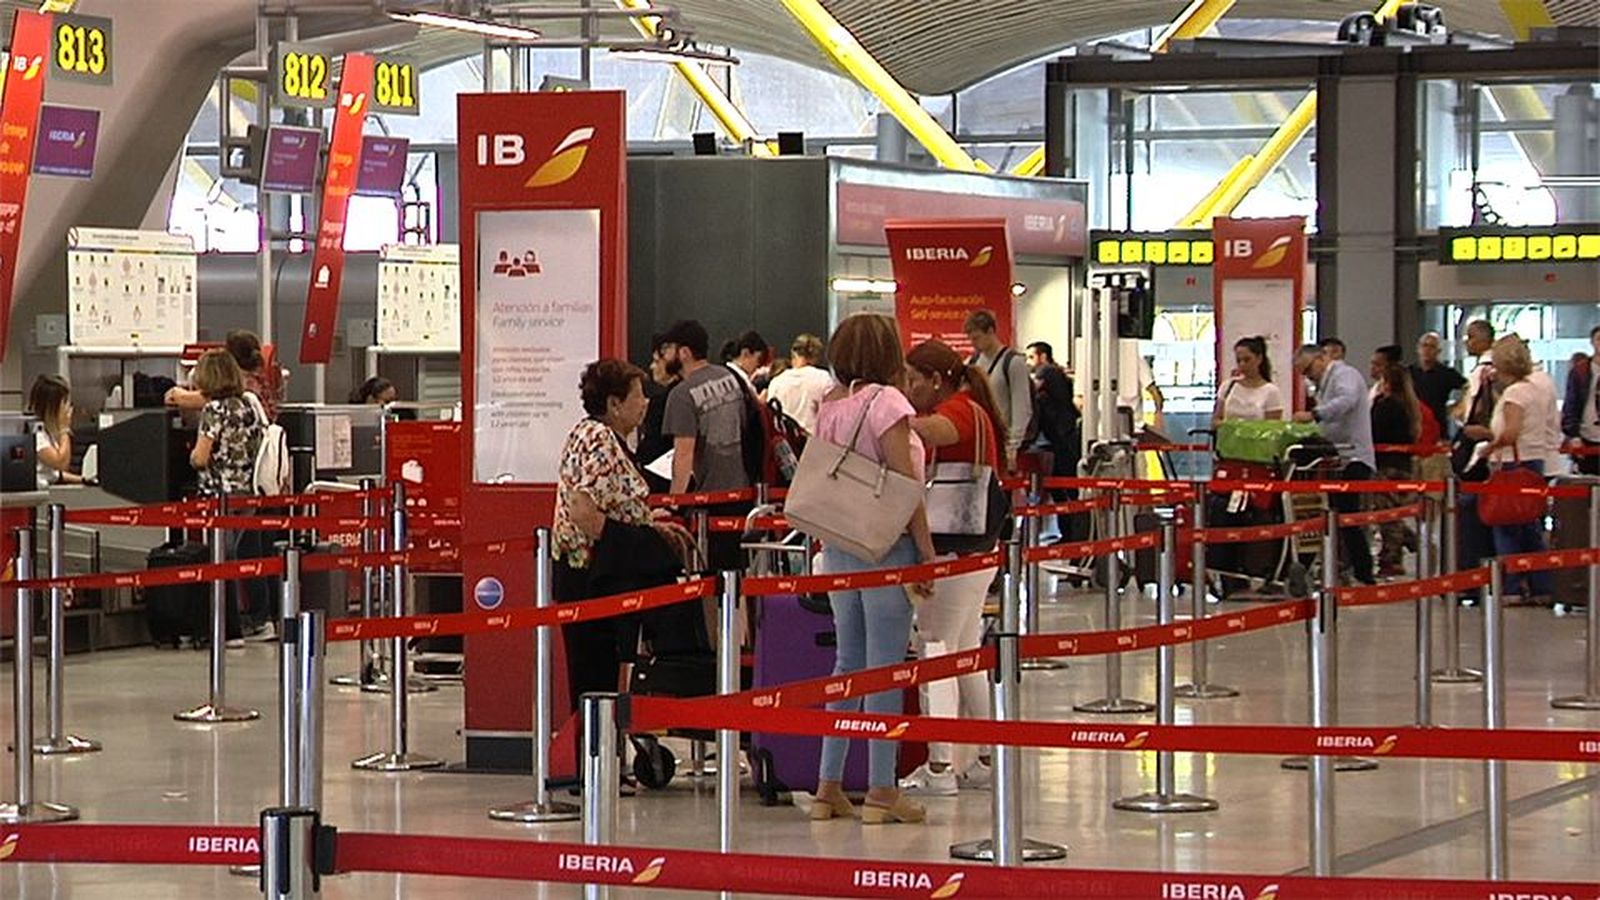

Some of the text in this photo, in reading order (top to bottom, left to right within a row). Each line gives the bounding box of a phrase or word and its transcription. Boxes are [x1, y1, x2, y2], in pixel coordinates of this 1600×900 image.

[57, 24, 105, 75] 813
[283, 52, 326, 99] 812
[376, 63, 415, 106] 811
[477, 134, 525, 166] IB
[906, 247, 969, 260] IBERIA
[1224, 239, 1253, 257] IB
[834, 719, 1600, 753] IBERIA IBERIA IBERIA IB
[189, 837, 260, 853] IBERIA
[558, 853, 1245, 899] IBERIA IBERIA IBERIA
